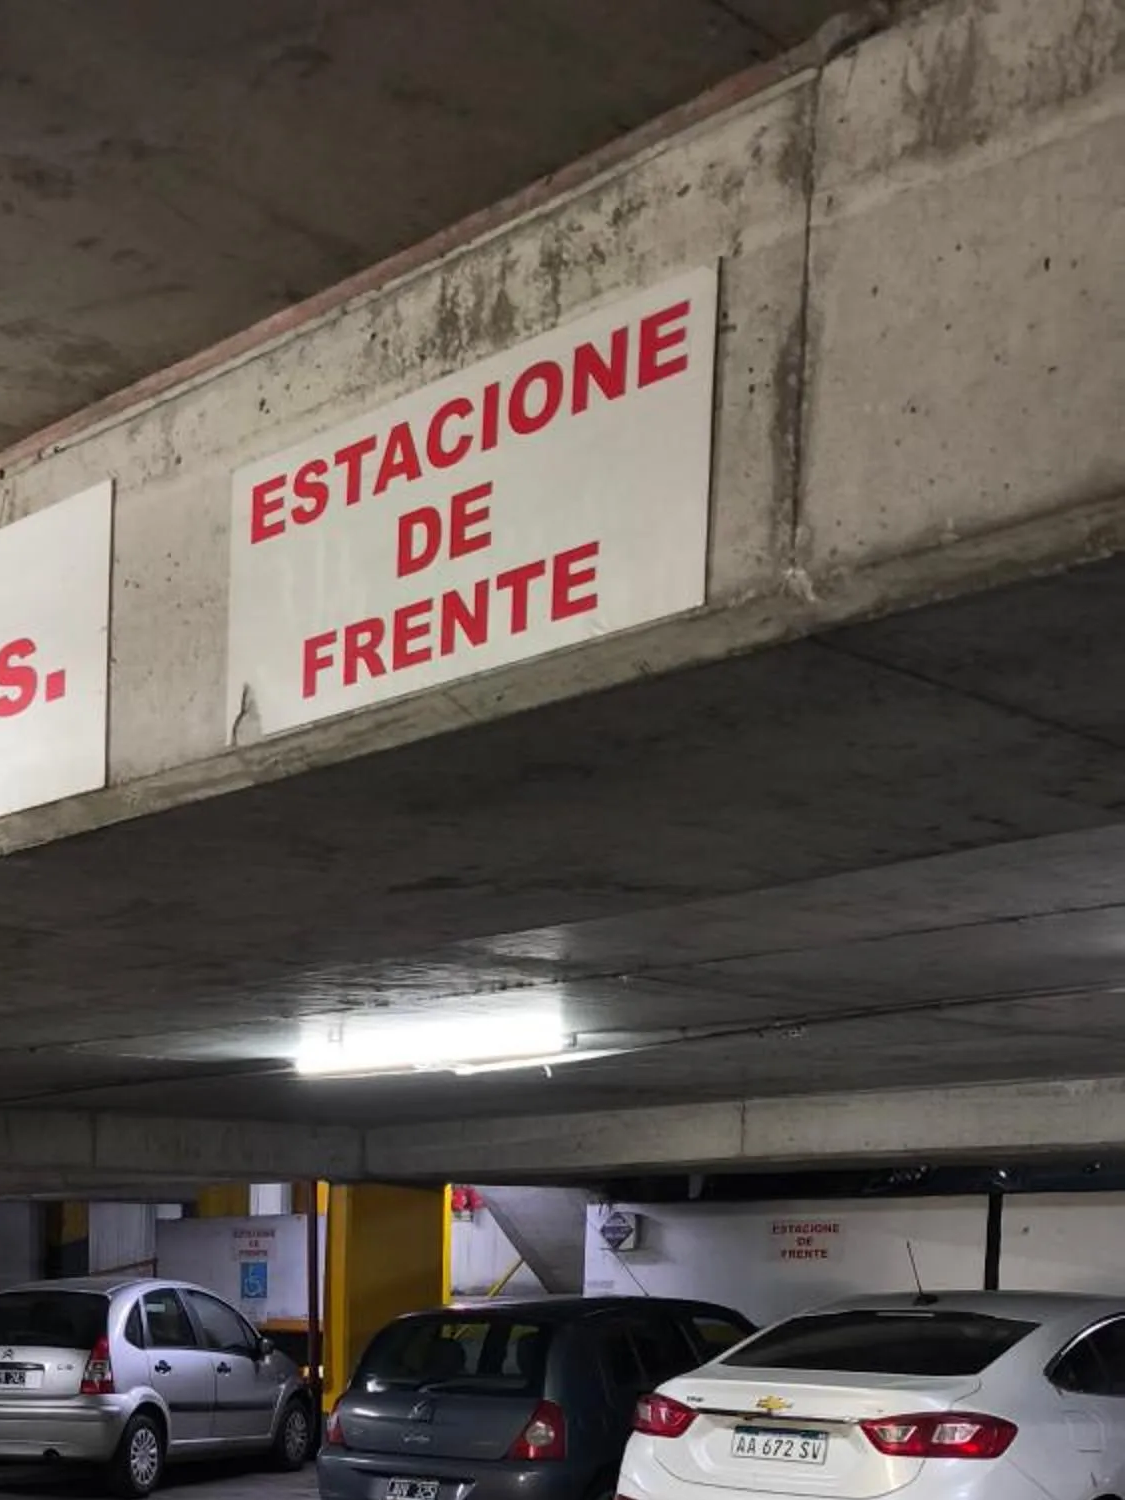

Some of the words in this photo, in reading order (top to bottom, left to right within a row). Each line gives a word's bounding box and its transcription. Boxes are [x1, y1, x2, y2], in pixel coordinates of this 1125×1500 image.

[250, 300, 693, 545] ESTACIONE
[395, 482, 494, 578] DE
[300, 541, 601, 700] FRENTE
[772, 1223, 840, 1234] ESTACIONE
[736, 1436, 757, 1454] AA
[762, 1439, 795, 1457] 672
[799, 1441, 822, 1460] SV
